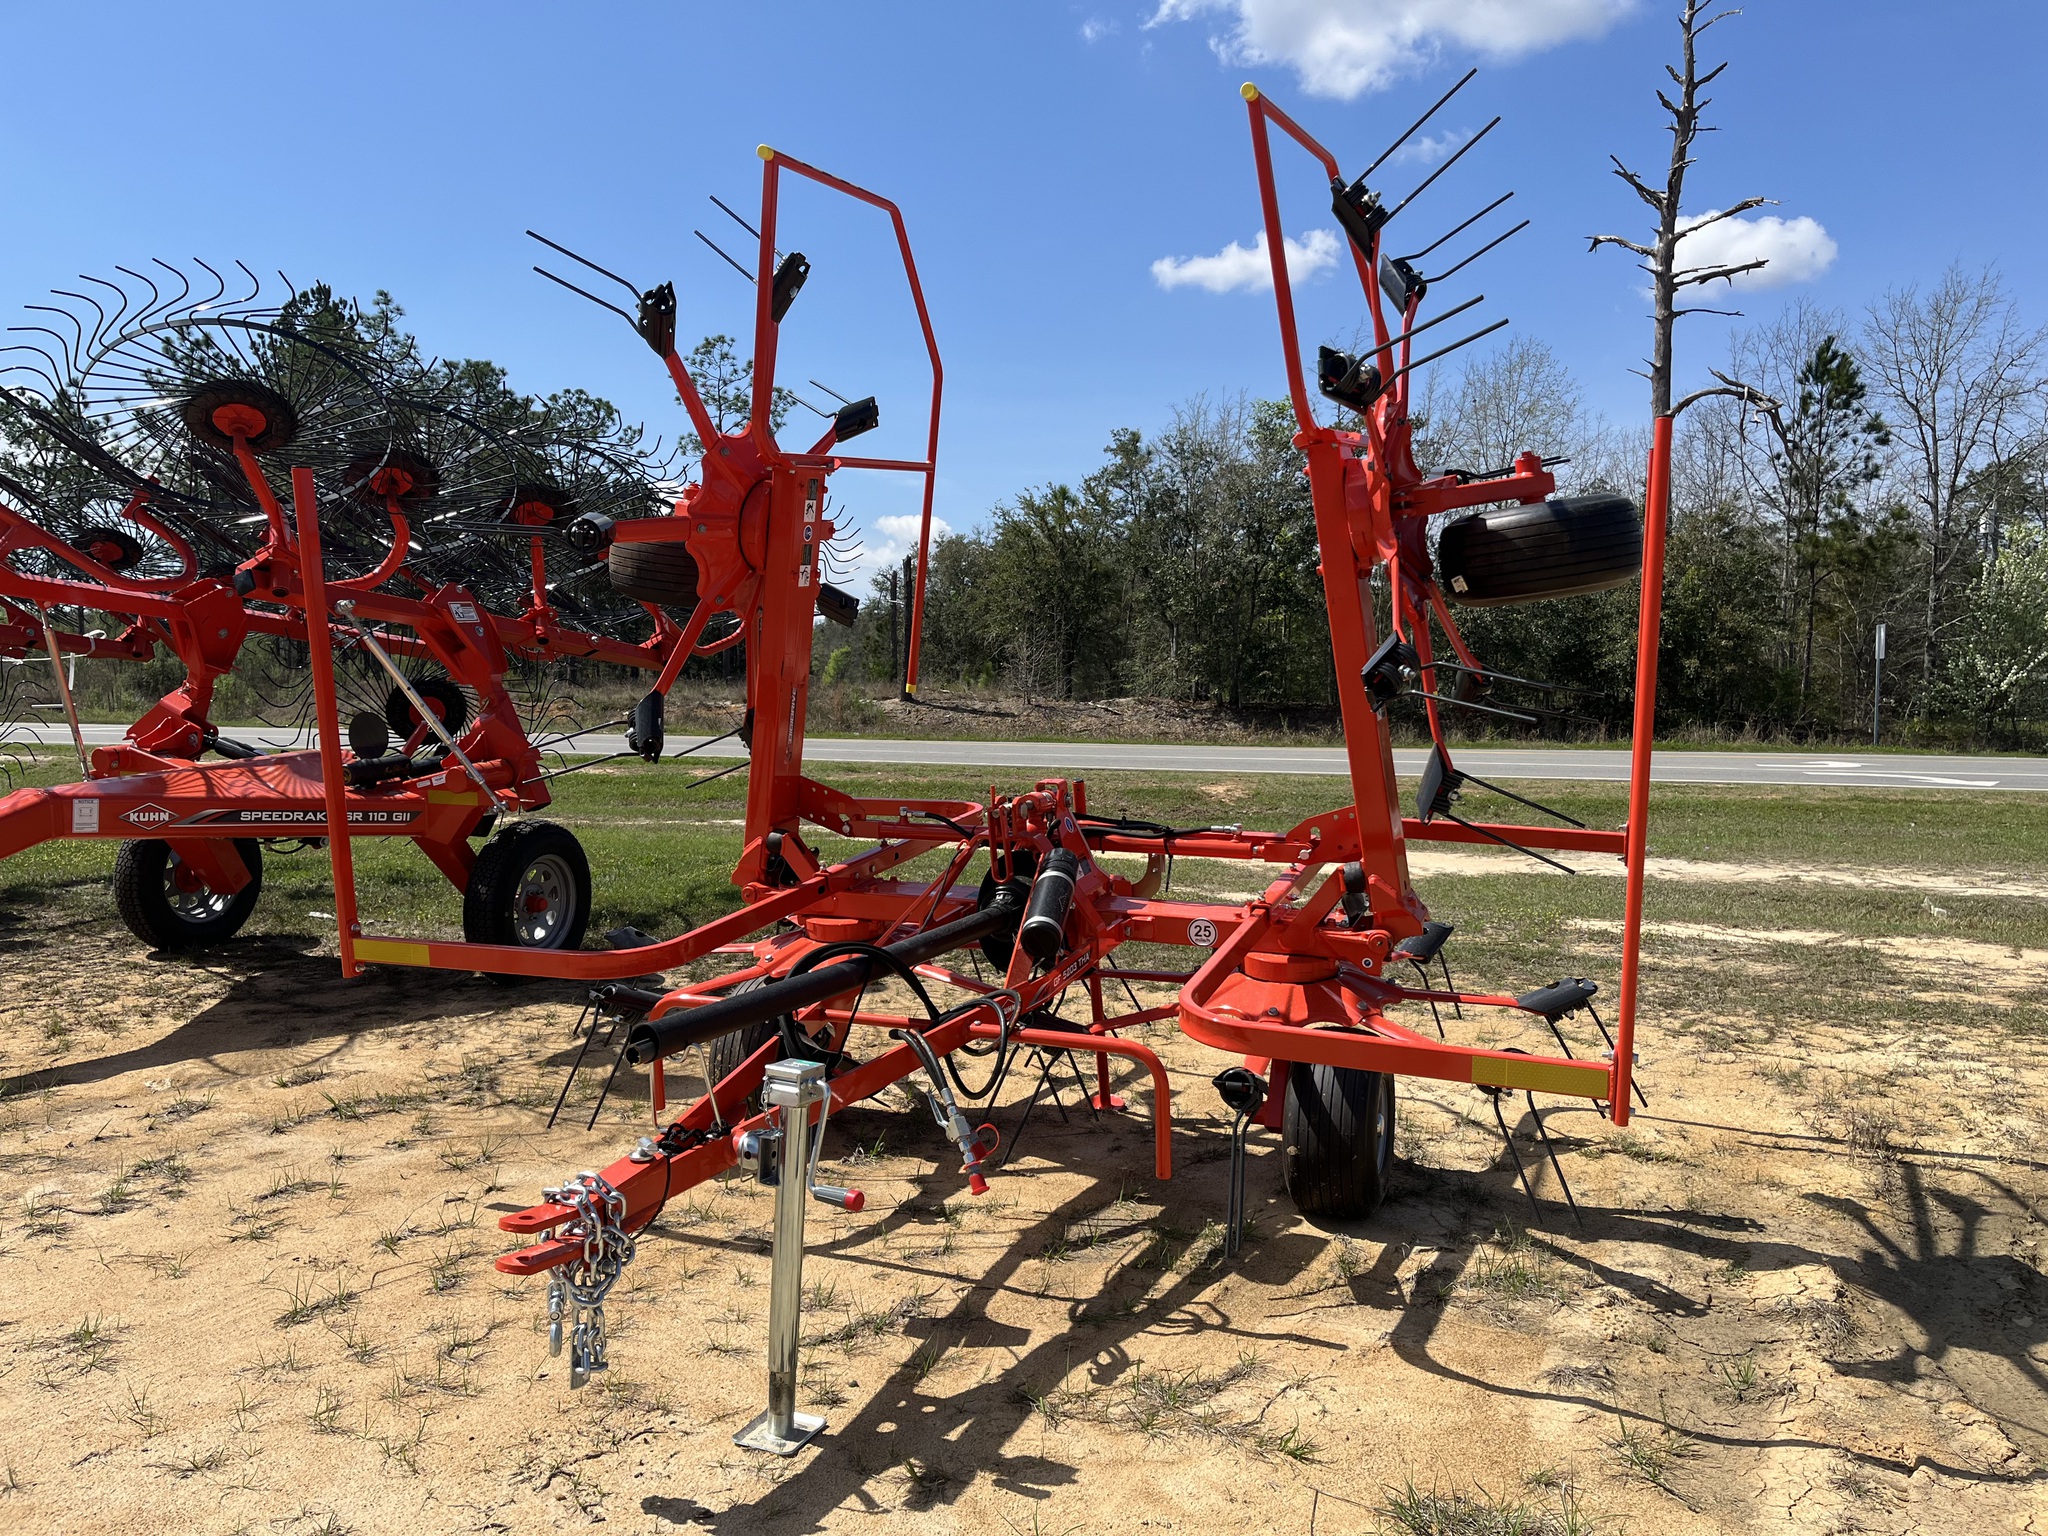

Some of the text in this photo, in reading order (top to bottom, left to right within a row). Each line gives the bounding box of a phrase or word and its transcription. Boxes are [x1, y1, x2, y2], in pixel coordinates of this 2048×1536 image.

[788, 687, 797, 742] DIGIDRIVE
[129, 812, 170, 822] KUHN
[240, 811, 331, 821] SPEEDRAK
[368, 812, 387, 821] 110
[1194, 925, 1211, 937] 25
[1053, 953, 1090, 987] GF 5203 THA
